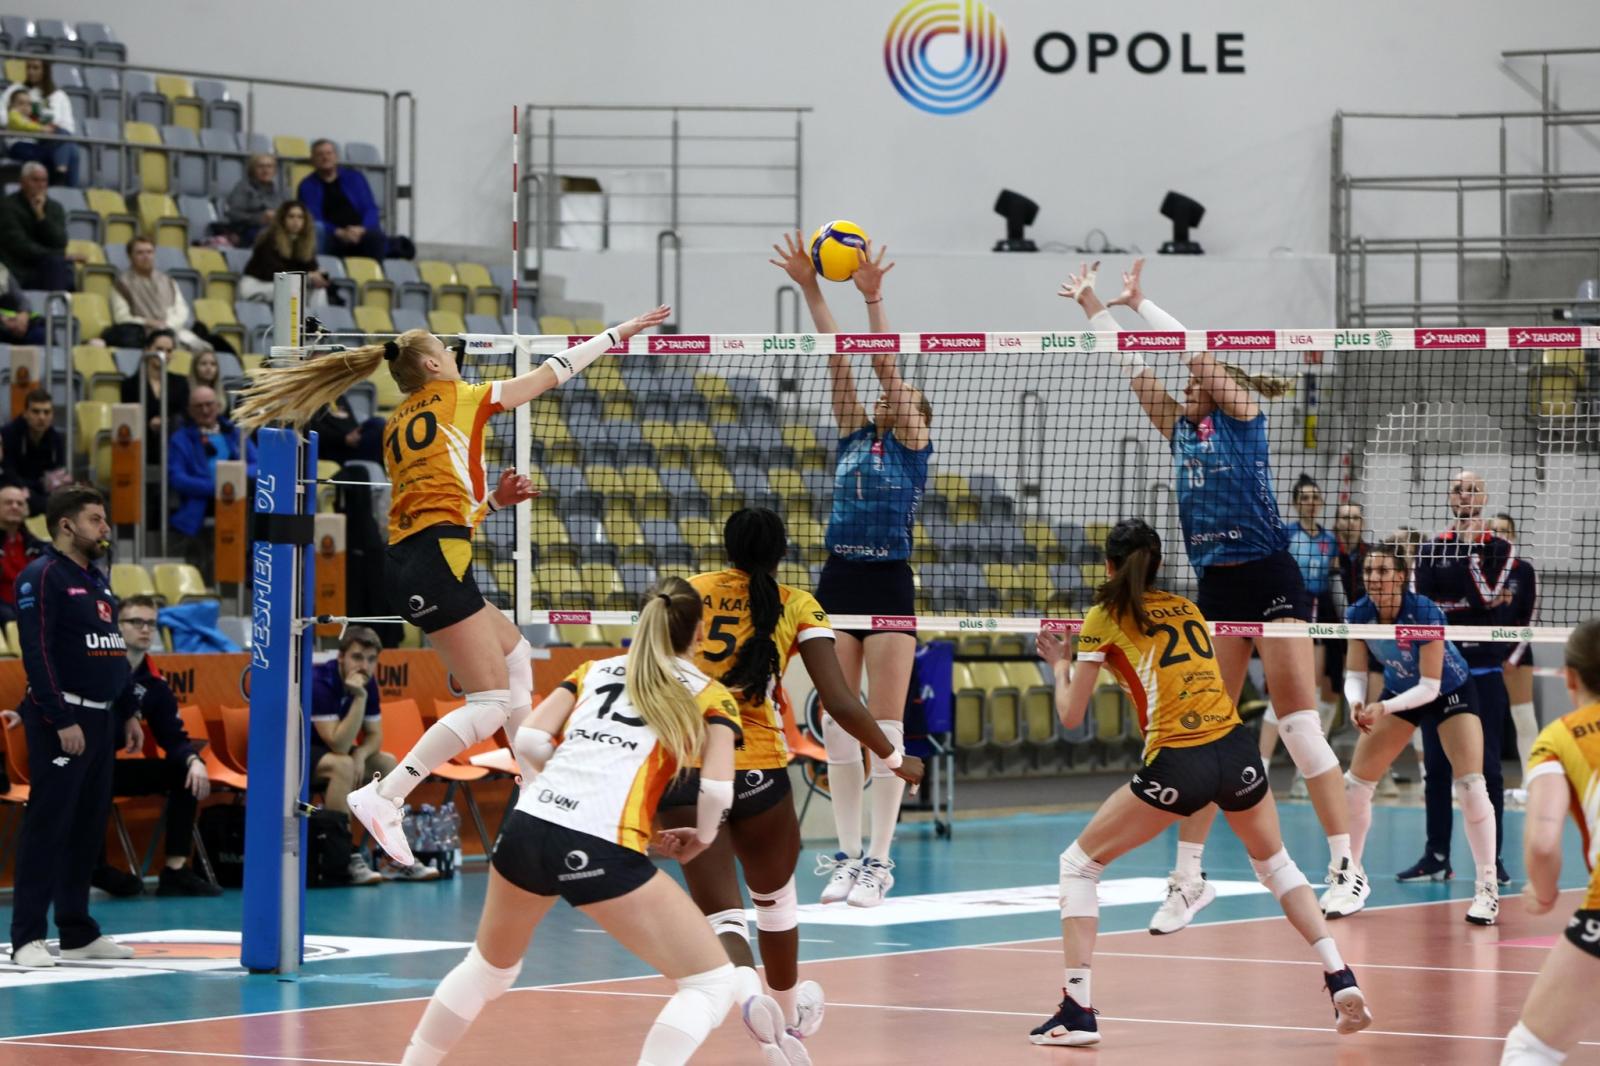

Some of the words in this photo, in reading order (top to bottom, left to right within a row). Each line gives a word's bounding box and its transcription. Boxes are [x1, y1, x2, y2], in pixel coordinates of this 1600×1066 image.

[1033, 31, 1246, 75] OPOLE
[469, 339, 494, 349] netex
[666, 339, 706, 350] TAURON
[722, 339, 745, 350] LIGA
[762, 335, 796, 353] plus
[855, 338, 895, 349] TAURON
[940, 337, 981, 348] TAURON
[999, 337, 1022, 348] LIGA
[1041, 332, 1076, 351] plus
[1139, 336, 1180, 347] TAURON
[1228, 335, 1271, 346] TAURON
[1289, 335, 1314, 346] LIGA
[1334, 330, 1371, 349] plus
[1436, 333, 1481, 344] TAURON
[1531, 332, 1576, 344] TAURON
[386, 410, 438, 464] 10
[250, 472, 277, 670] PESMENOL
[703, 615, 740, 662] 5
[959, 618, 984, 631] plus
[1230, 625, 1260, 634] TAURON
[1308, 624, 1334, 637] plus
[1410, 629, 1441, 639] TAURON
[1491, 627, 1518, 640] plus
[1146, 619, 1215, 668] 20
[377, 662, 409, 688] UNI
[554, 794, 580, 811] UNI
[1143, 780, 1179, 806] 20
